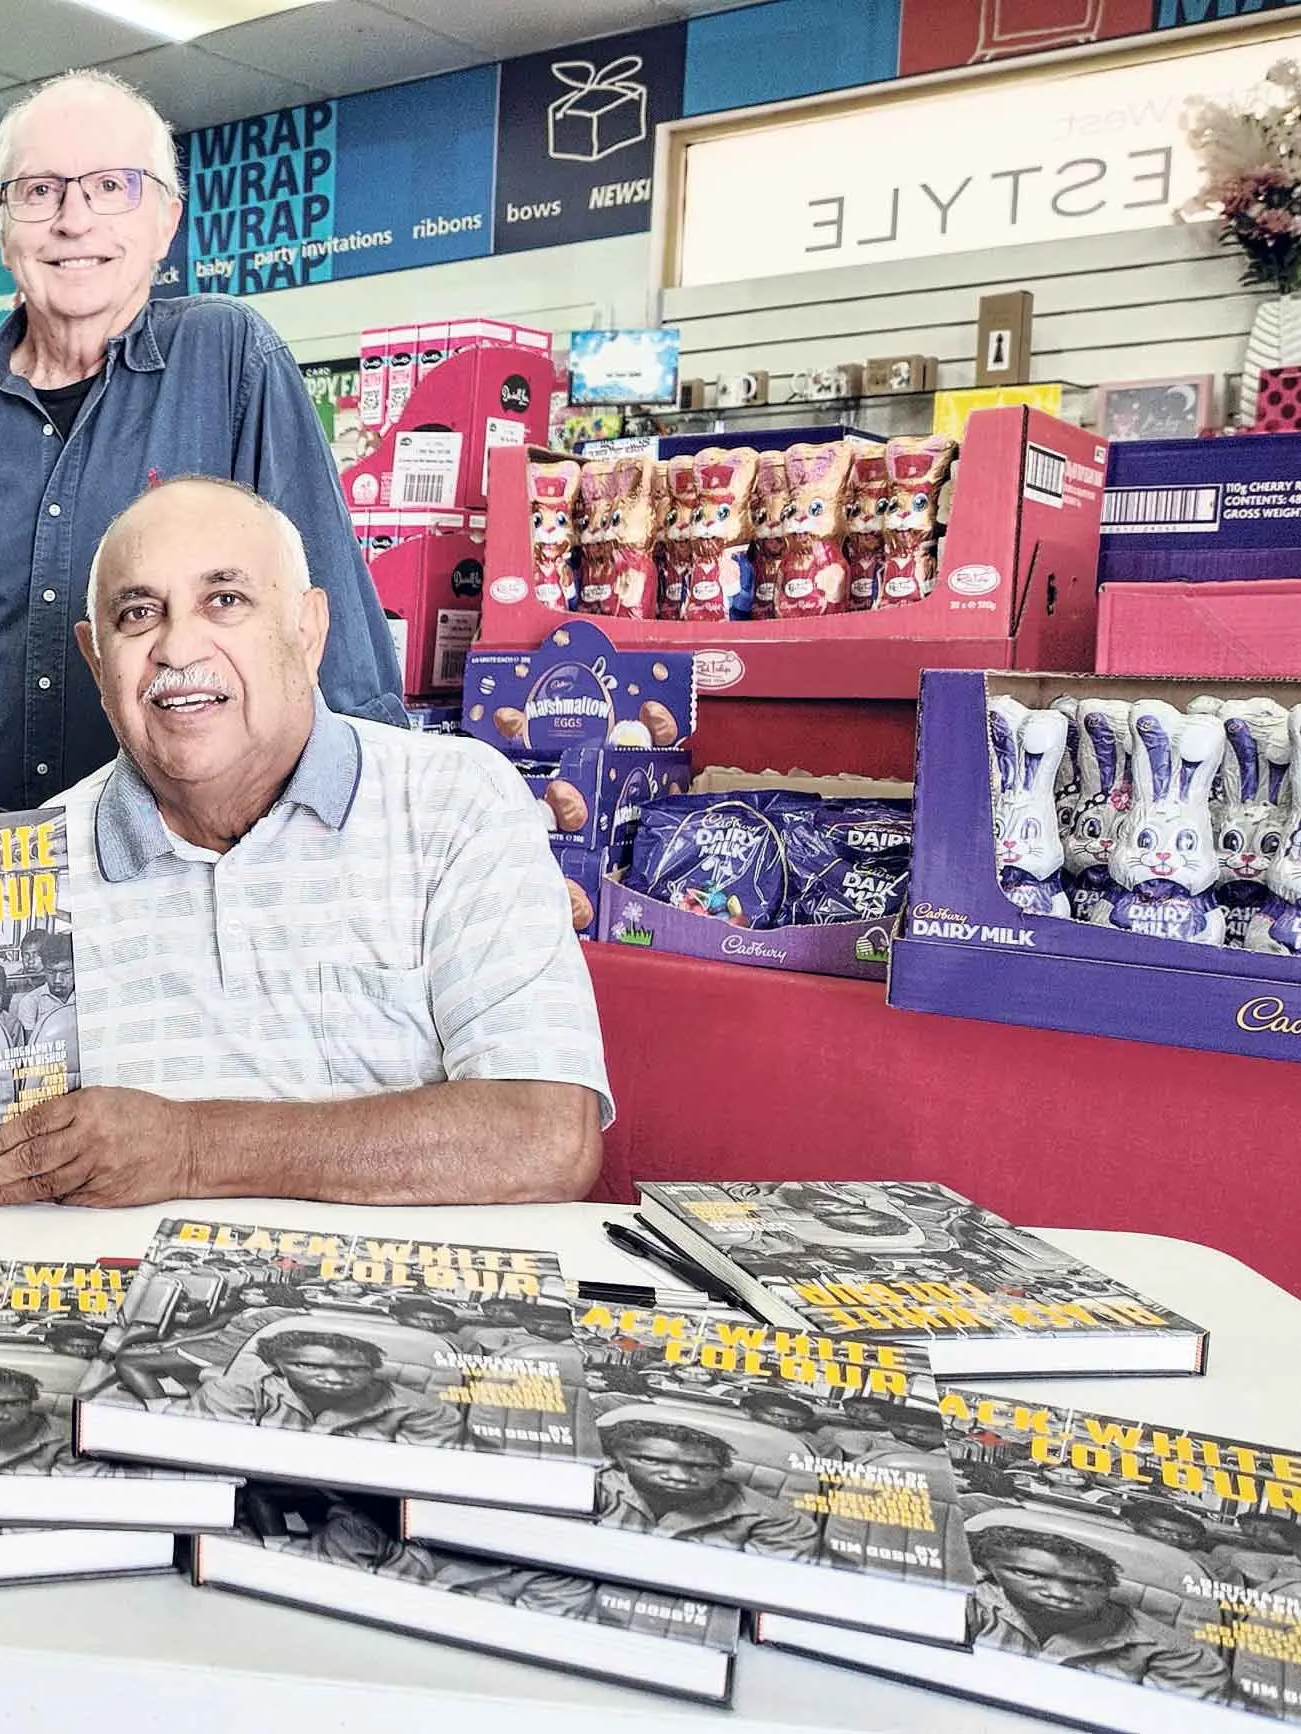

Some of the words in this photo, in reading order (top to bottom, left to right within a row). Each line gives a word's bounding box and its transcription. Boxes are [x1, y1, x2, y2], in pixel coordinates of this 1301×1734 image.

[199, 102, 333, 169] WRAP
[196, 149, 332, 212] WRAP
[507, 201, 561, 222] bows
[194, 194, 330, 257] WRAP
[413, 213, 483, 239] ribbons
[254, 245, 298, 270] party
[303, 228, 393, 258] invitations
[196, 259, 235, 278] baby
[1249, 481, 1294, 493] CHERRY
[1224, 494, 1287, 506] CONTENTS:
[1223, 508, 1261, 520] GROSS
[526, 697, 611, 720] Marshmallow
[553, 718, 583, 728] EGGS
[696, 828, 763, 848] DAIRY
[700, 843, 751, 862] MILK
[912, 902, 969, 924] Cadbury
[913, 919, 980, 943] DAIRY
[980, 926, 1037, 947] MILK
[721, 935, 788, 964] Cadbury
[4, 1042, 55, 1059] BIOGRAPHY
[57, 1040, 67, 1051] OF
[365, 1240, 541, 1274] WHITE
[25, 1264, 138, 1291] WHI
[320, 1257, 542, 1297] COLOUR
[788, 1281, 992, 1306] COLOUR
[823, 1303, 984, 1331] WHITE
[716, 1322, 907, 1368] WHITE
[665, 1341, 909, 1397] COLOUR
[472, 1425, 501, 1437] TIM
[830, 1539, 862, 1554] TIM
[601, 1594, 631, 1611] TIM
[1240, 1678, 1278, 1698] TIM
